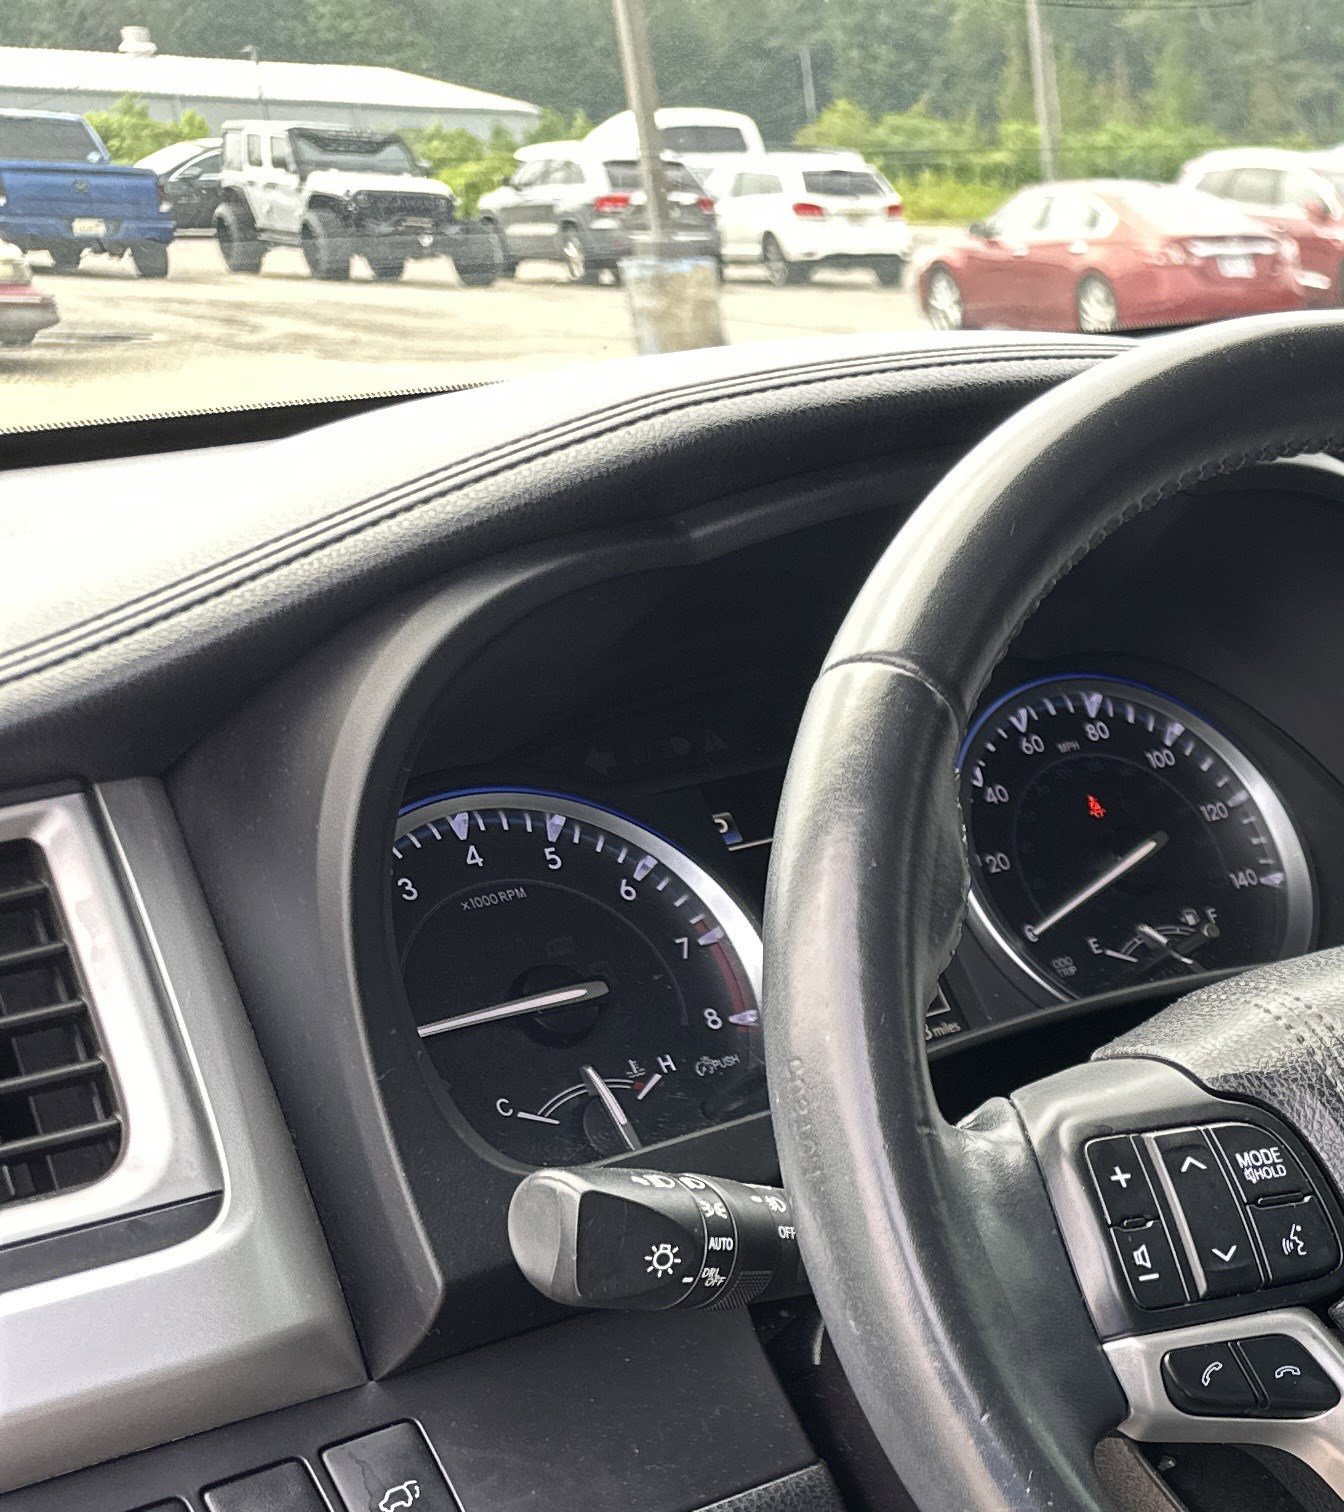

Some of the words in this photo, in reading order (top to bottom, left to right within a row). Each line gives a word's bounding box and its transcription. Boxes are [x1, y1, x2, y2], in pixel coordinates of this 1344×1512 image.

[1084, 721, 1110, 741] 80
[1020, 735, 1045, 755] 60
[1146, 747, 1175, 769] 100
[986, 784, 1010, 804] 40
[1201, 802, 1229, 822] 120
[466, 845, 484, 868] 4
[544, 846, 563, 870] 5
[986, 853, 1011, 874] 20
[1230, 868, 1258, 889] 140
[397, 877, 419, 901] 3
[619, 878, 637, 901] 6
[1205, 907, 1218, 923] F
[674, 937, 690, 960] 7
[1088, 937, 1103, 954] E
[703, 1007, 722, 1030] 8
[657, 1053, 677, 1074] H
[495, 1098, 514, 1118] C
[1235, 1146, 1283, 1168] MODE
[1256, 1163, 1287, 1181] HOLD
[778, 1225, 796, 1239] OFF
[708, 1236, 734, 1251] AUTO
[701, 1267, 720, 1278] DRL
[704, 1276, 727, 1287] OFF
